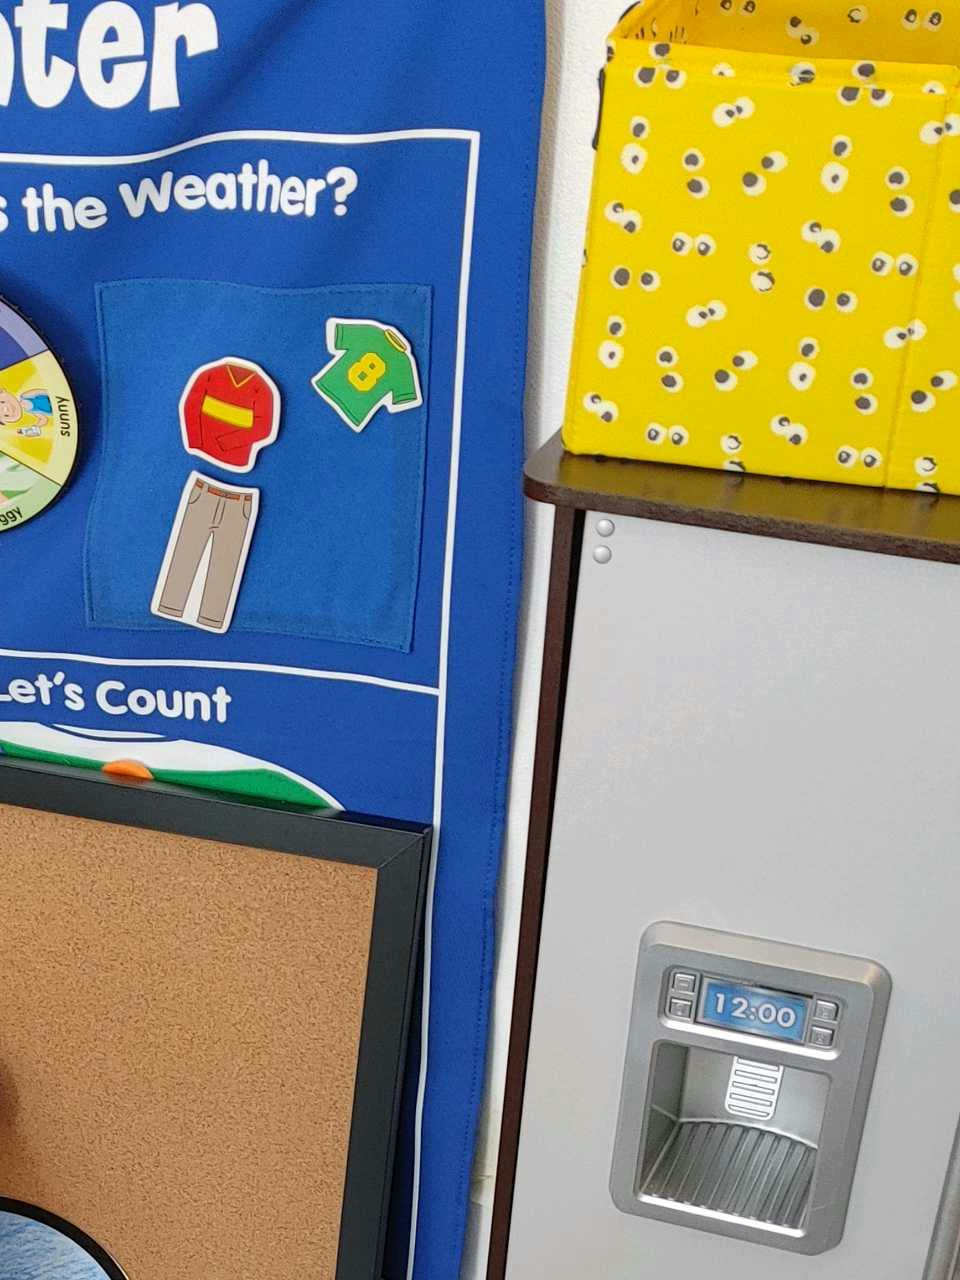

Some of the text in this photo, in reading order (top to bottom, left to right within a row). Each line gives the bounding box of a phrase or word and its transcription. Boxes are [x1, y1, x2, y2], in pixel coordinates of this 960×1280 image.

[21, 181, 108, 233] the
[118, 158, 359, 218] Weather?
[347, 351, 386, 392] 8
[55, 396, 71, 437] sunny
[95, 680, 232, 723] Count
[715, 993, 797, 1029] 12:00
